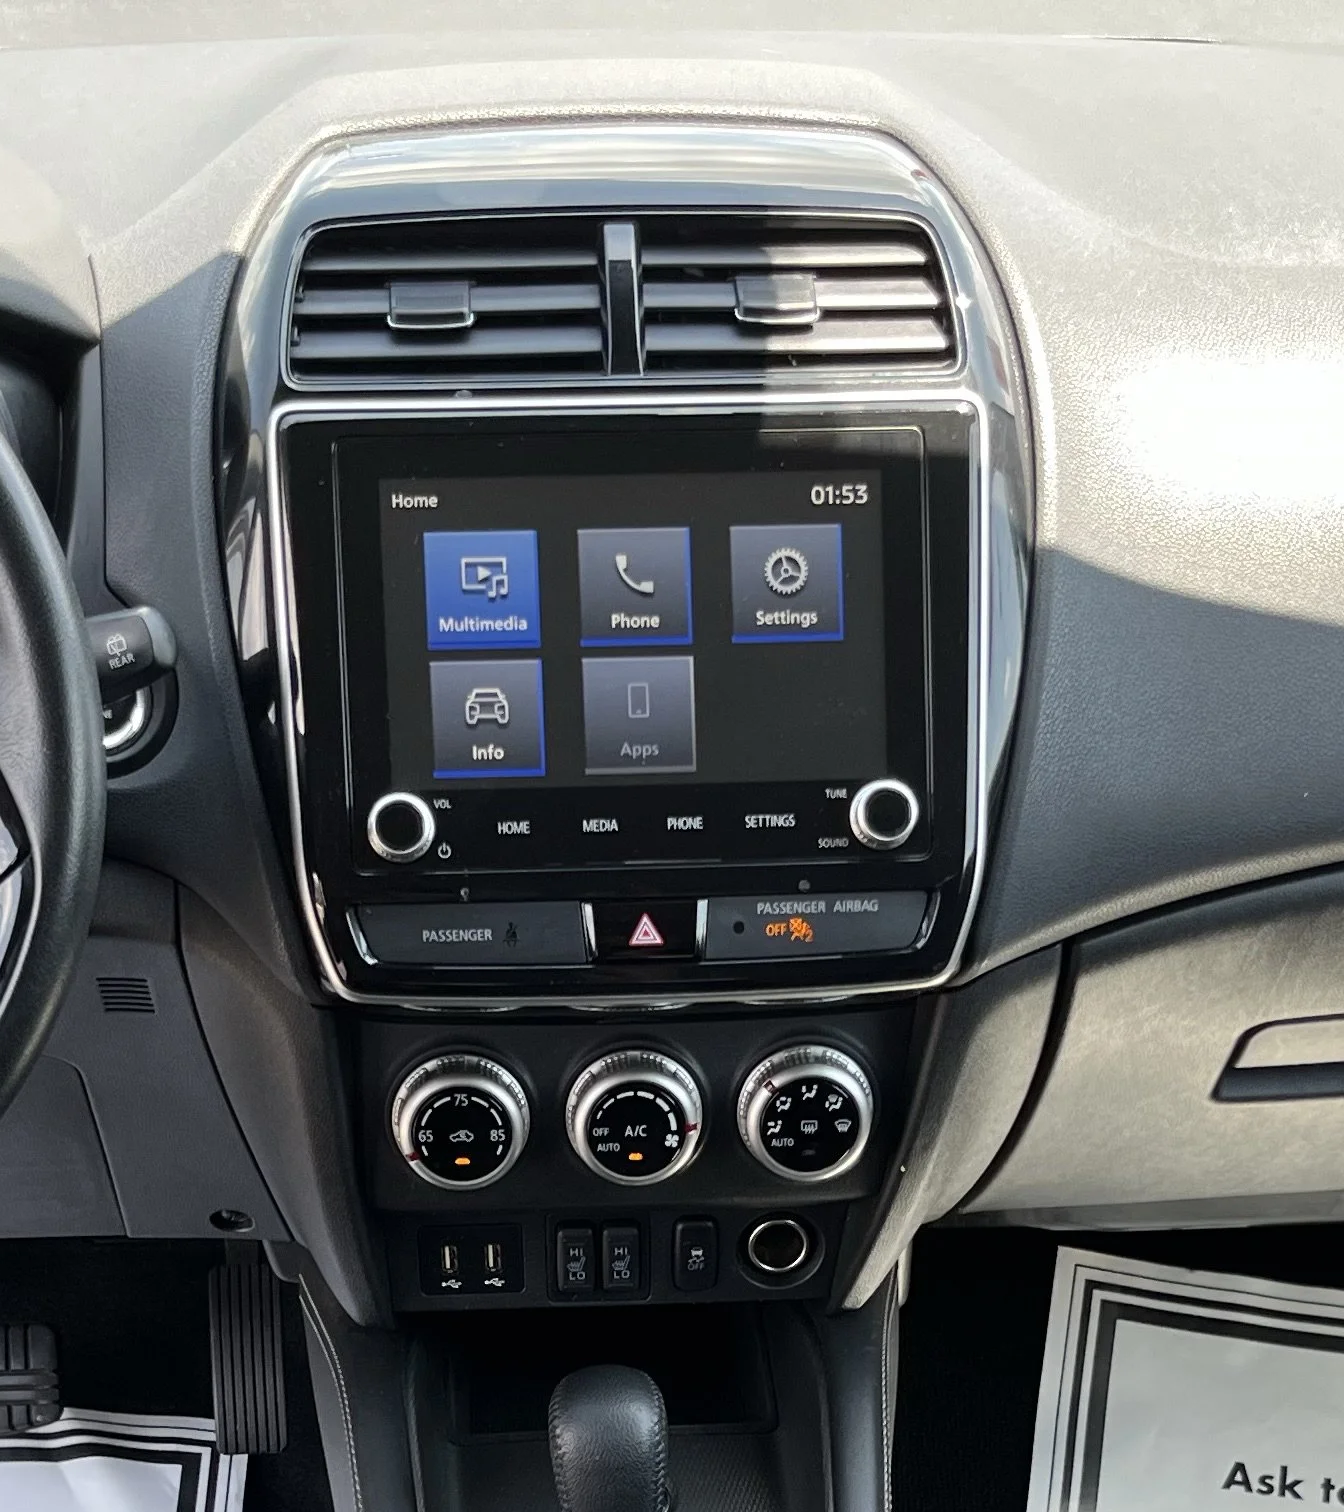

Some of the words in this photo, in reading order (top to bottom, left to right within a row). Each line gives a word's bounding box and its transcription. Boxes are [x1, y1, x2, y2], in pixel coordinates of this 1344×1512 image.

[391, 494, 439, 509] Home
[810, 484, 869, 505] 01:53
[438, 616, 528, 633] Multimedia
[611, 613, 660, 629] Phone
[756, 609, 818, 628] Settings
[108, 653, 136, 670] REAR
[472, 743, 505, 761] Info
[620, 741, 660, 759] Apps
[825, 788, 847, 799] TUNE
[433, 799, 452, 809] VOL
[497, 820, 531, 835] HOME
[582, 819, 619, 833] MEDIA
[667, 816, 704, 831] PHONE
[745, 814, 796, 828] SETTINGS
[818, 838, 849, 848] SOUND
[756, 900, 827, 915] PASSENGER
[833, 899, 879, 913] AIRBAG
[422, 928, 493, 943] PASSENGER
[765, 923, 788, 937] OFF
[453, 1093, 469, 1107] 75
[418, 1130, 434, 1142] 65
[490, 1129, 506, 1142] 85
[592, 1127, 610, 1137] OFF
[624, 1125, 648, 1137] A/C
[597, 1143, 620, 1152] AUTO
[771, 1138, 795, 1147] AUTO
[569, 1248, 584, 1257] HI
[614, 1247, 628, 1256] HI
[687, 1262, 704, 1271] OFF
[569, 1271, 586, 1281] LO
[613, 1270, 631, 1280] LO
[1221, 1461, 1305, 1501] Ask
